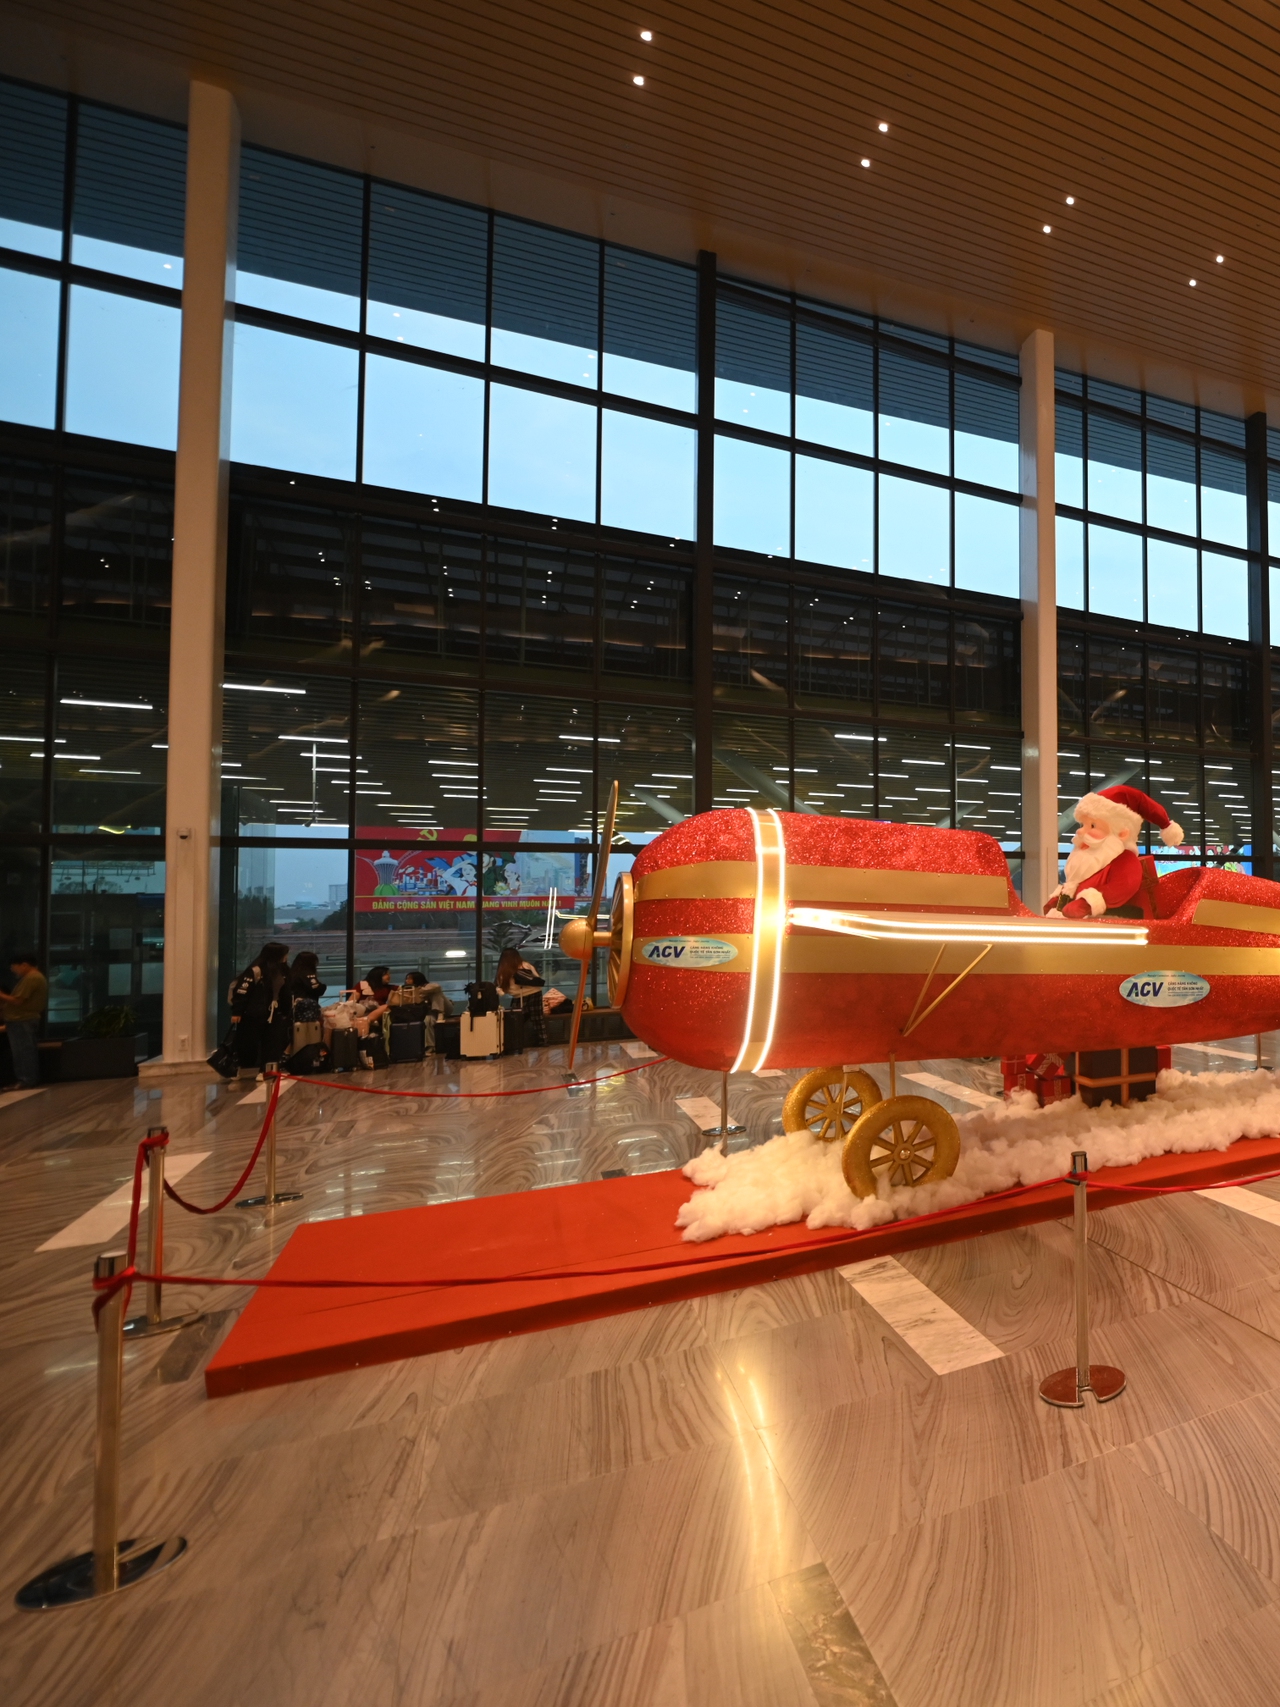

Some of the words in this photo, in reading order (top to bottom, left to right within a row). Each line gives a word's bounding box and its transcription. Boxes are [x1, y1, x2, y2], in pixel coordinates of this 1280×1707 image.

[456, 900, 475, 909] NAM
[648, 945, 685, 959] ACV
[1126, 981, 1164, 998] ACV
